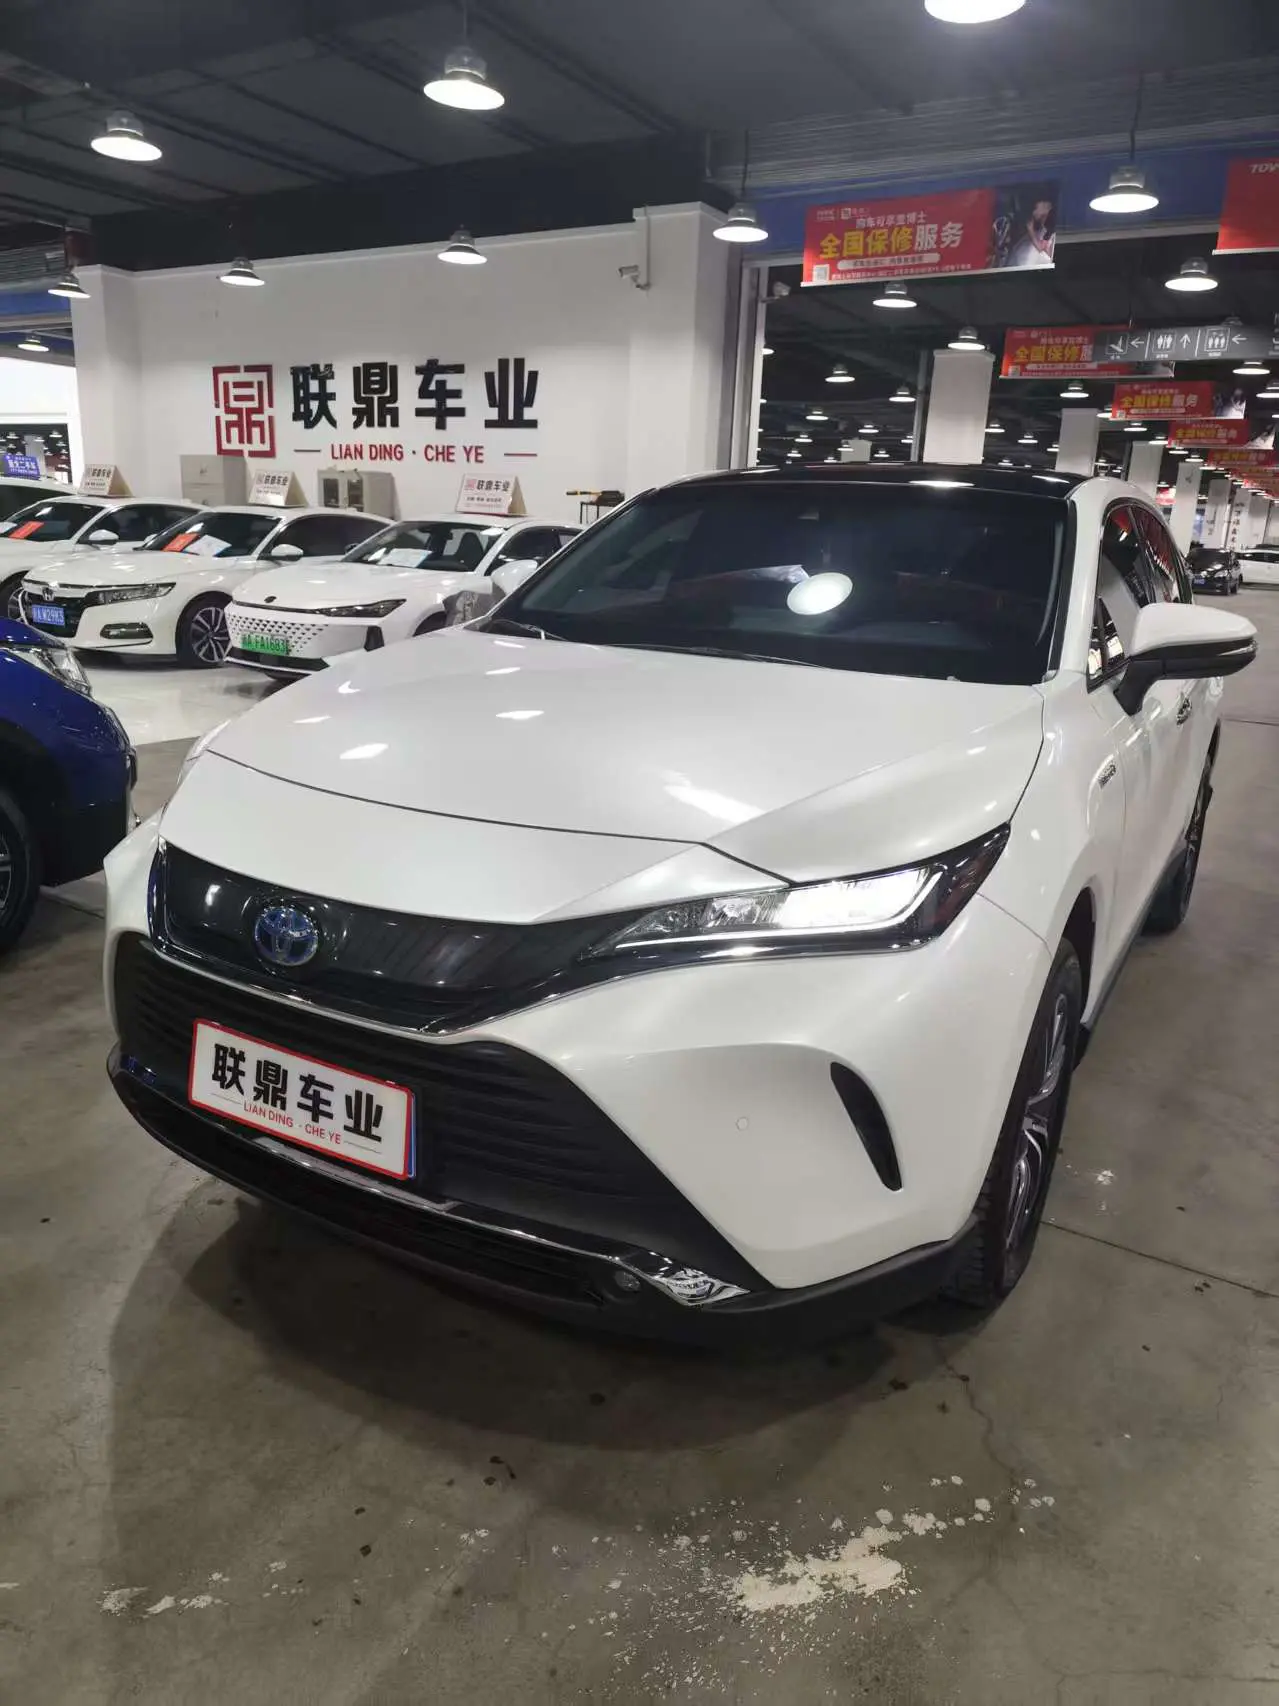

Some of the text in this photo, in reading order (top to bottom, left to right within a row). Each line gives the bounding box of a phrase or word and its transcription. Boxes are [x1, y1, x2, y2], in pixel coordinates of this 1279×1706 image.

[818, 221, 964, 259] 全国保修服务
[289, 357, 538, 430] 联鼎车业
[330, 443, 485, 463] LIAN DING CHE YE
[211, 1043, 383, 1142] 联鼎车业
[243, 1099, 342, 1145] LIAN DING CHE YE
